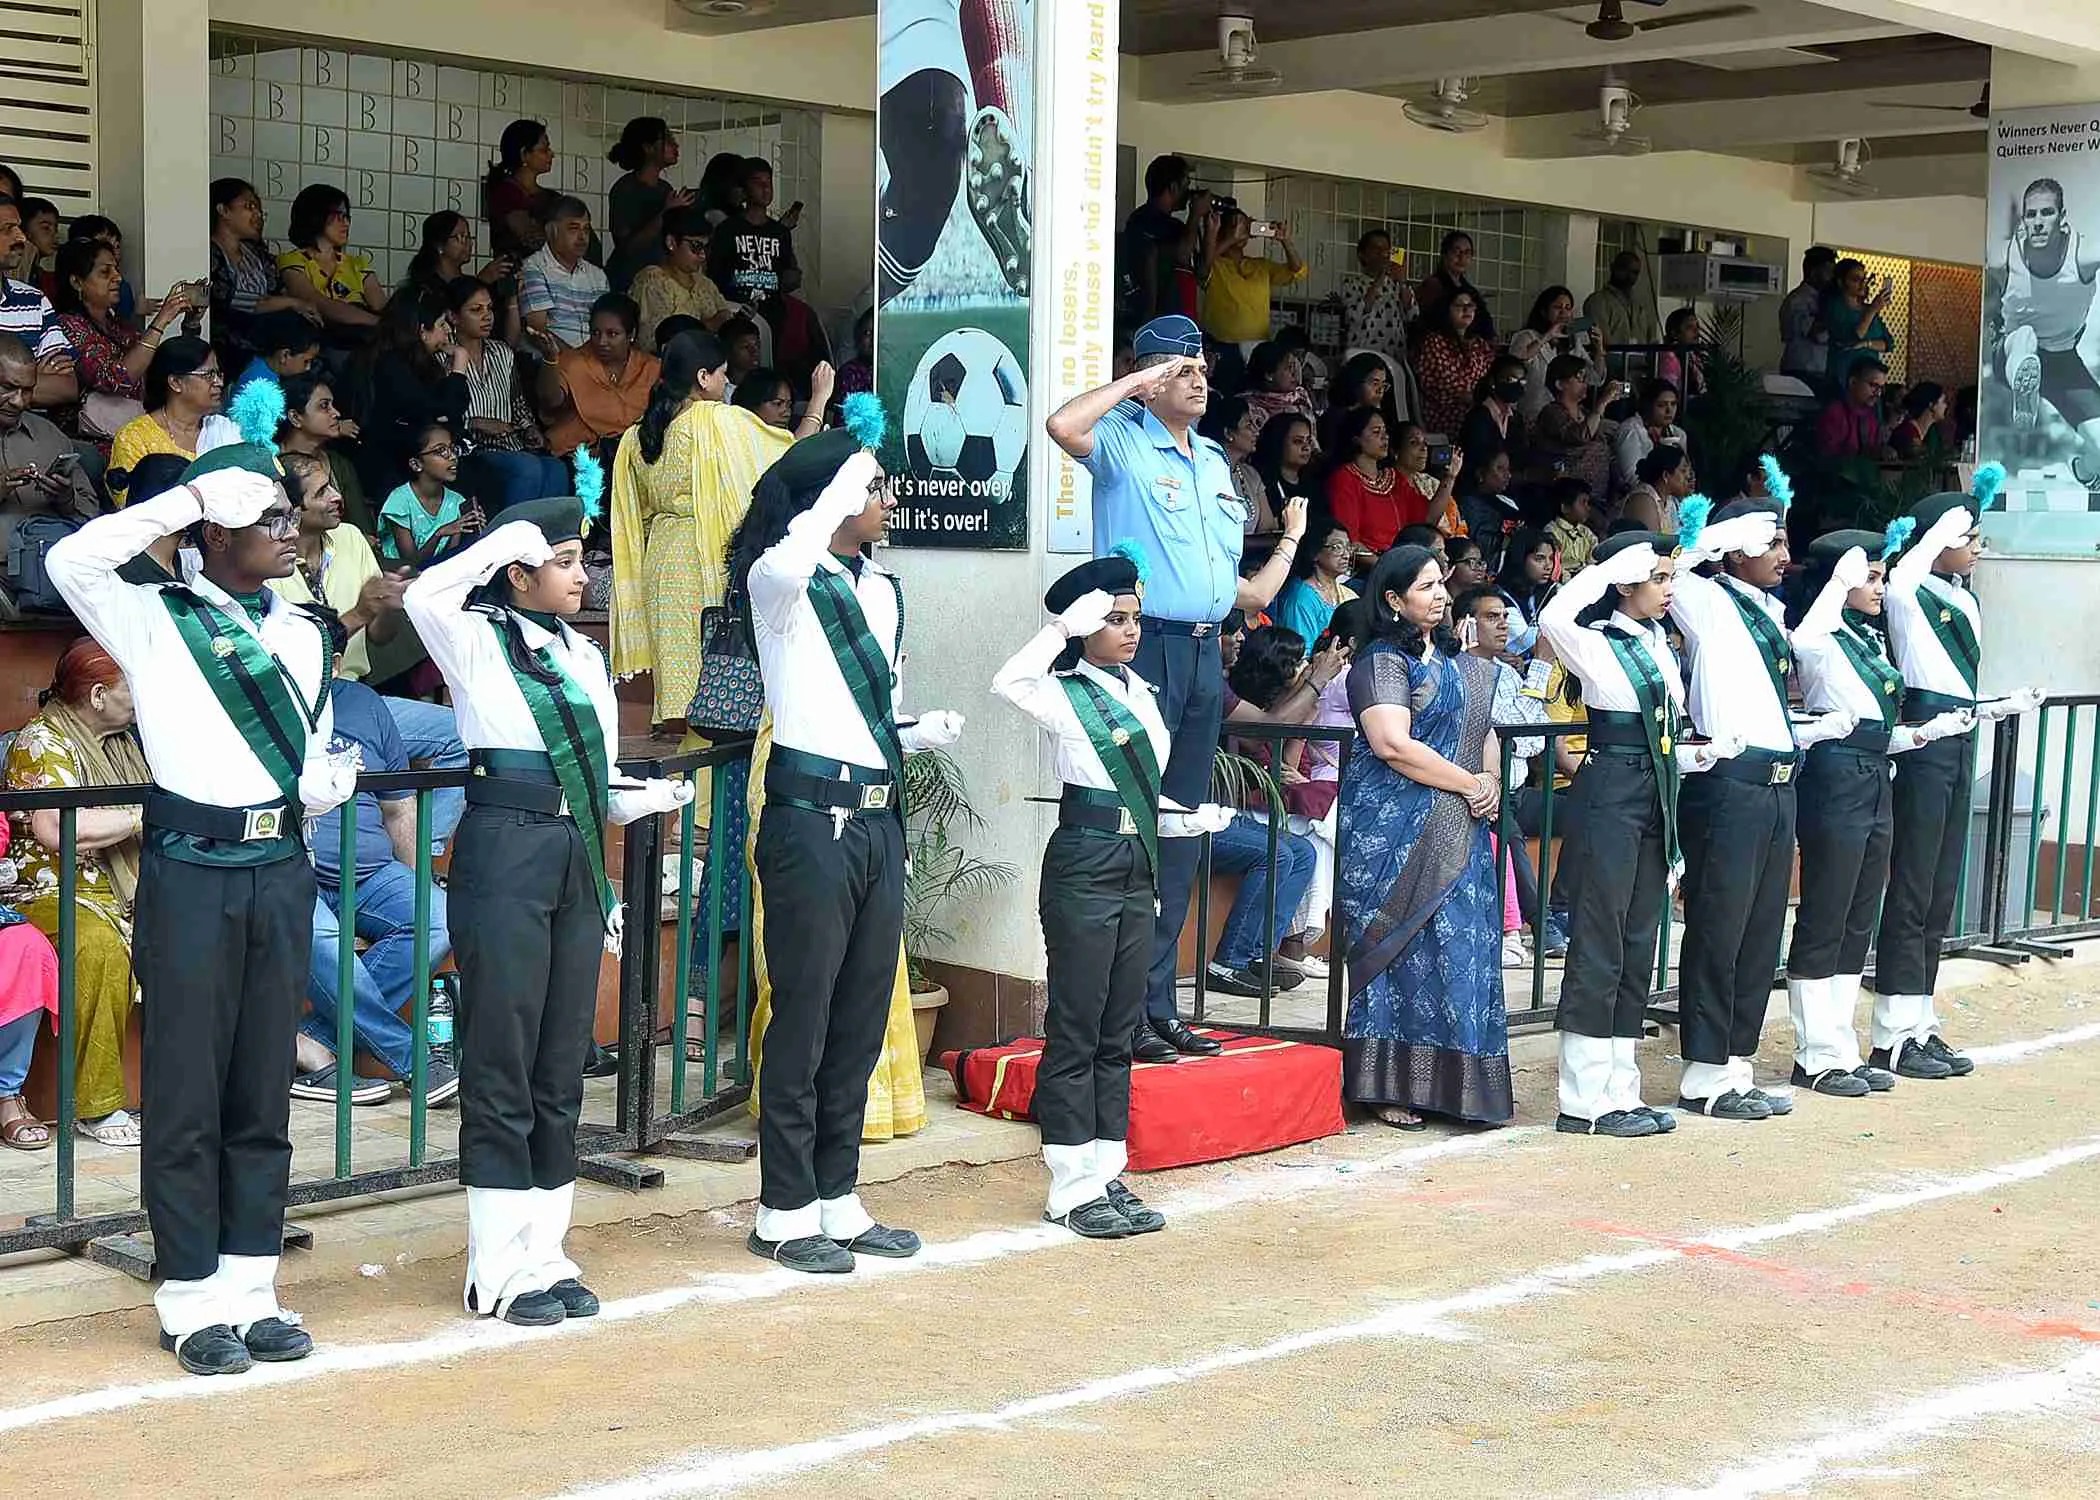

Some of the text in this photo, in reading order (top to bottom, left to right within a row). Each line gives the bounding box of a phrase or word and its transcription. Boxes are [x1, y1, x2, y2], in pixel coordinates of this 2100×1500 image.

[1086, 2, 1105, 63] hard
[1086, 72, 1106, 106] try
[1997, 125, 2048, 139] Winners
[2050, 122, 2088, 135] Never
[1083, 116, 1102, 190] didn't
[1996, 143, 2045, 158] Quitters
[2048, 141, 2085, 153] Never
[735, 234, 780, 257] NEVER
[1059, 262, 1080, 345] losers,
[1082, 263, 1101, 331] those
[1062, 357, 1076, 386] no
[889, 474, 1013, 501] It's never over,
[890, 507, 989, 532] till it's over!
